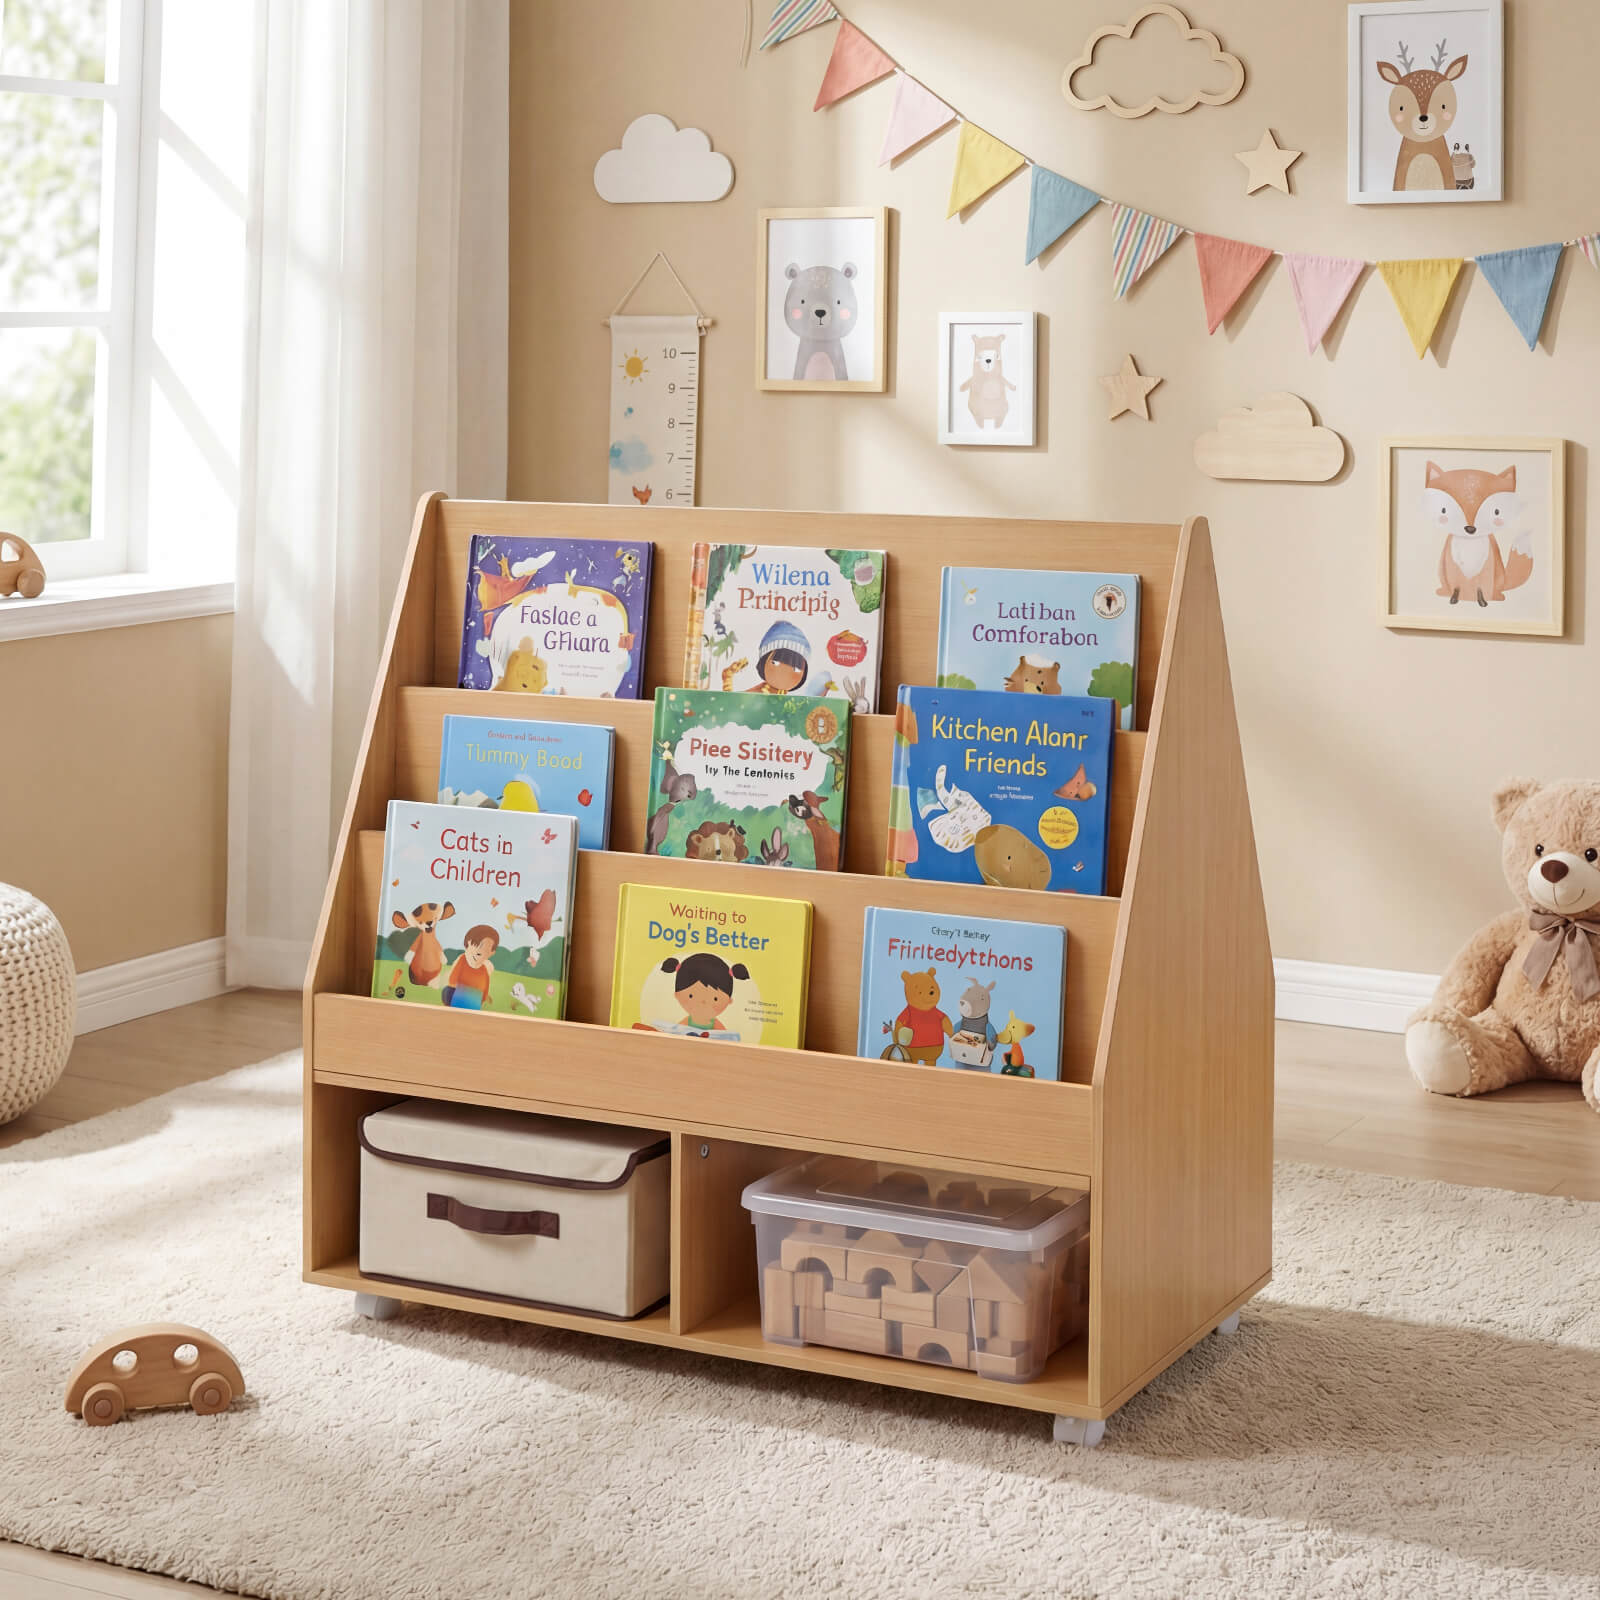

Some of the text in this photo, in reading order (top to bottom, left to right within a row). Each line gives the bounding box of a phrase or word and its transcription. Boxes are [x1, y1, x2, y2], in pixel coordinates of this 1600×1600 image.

[662, 347, 677, 360] 10
[667, 383, 676, 394] 9
[667, 418, 675, 429] 8
[666, 453, 675, 464] 7
[665, 488, 673, 500] 6
[752, 563, 831, 586] Wilena
[586, 614, 598, 627] a
[972, 623, 1099, 647] Comforabon
[931, 713, 1018, 744] Kitchen
[690, 737, 813, 771] Piee Sisitery
[964, 748, 1048, 777] Friends
[723, 765, 740, 776] The
[440, 828, 513, 855] Cats in
[430, 857, 521, 888] Children
[669, 902, 747, 925] Waiting to
[648, 921, 770, 951] Dog's Better
